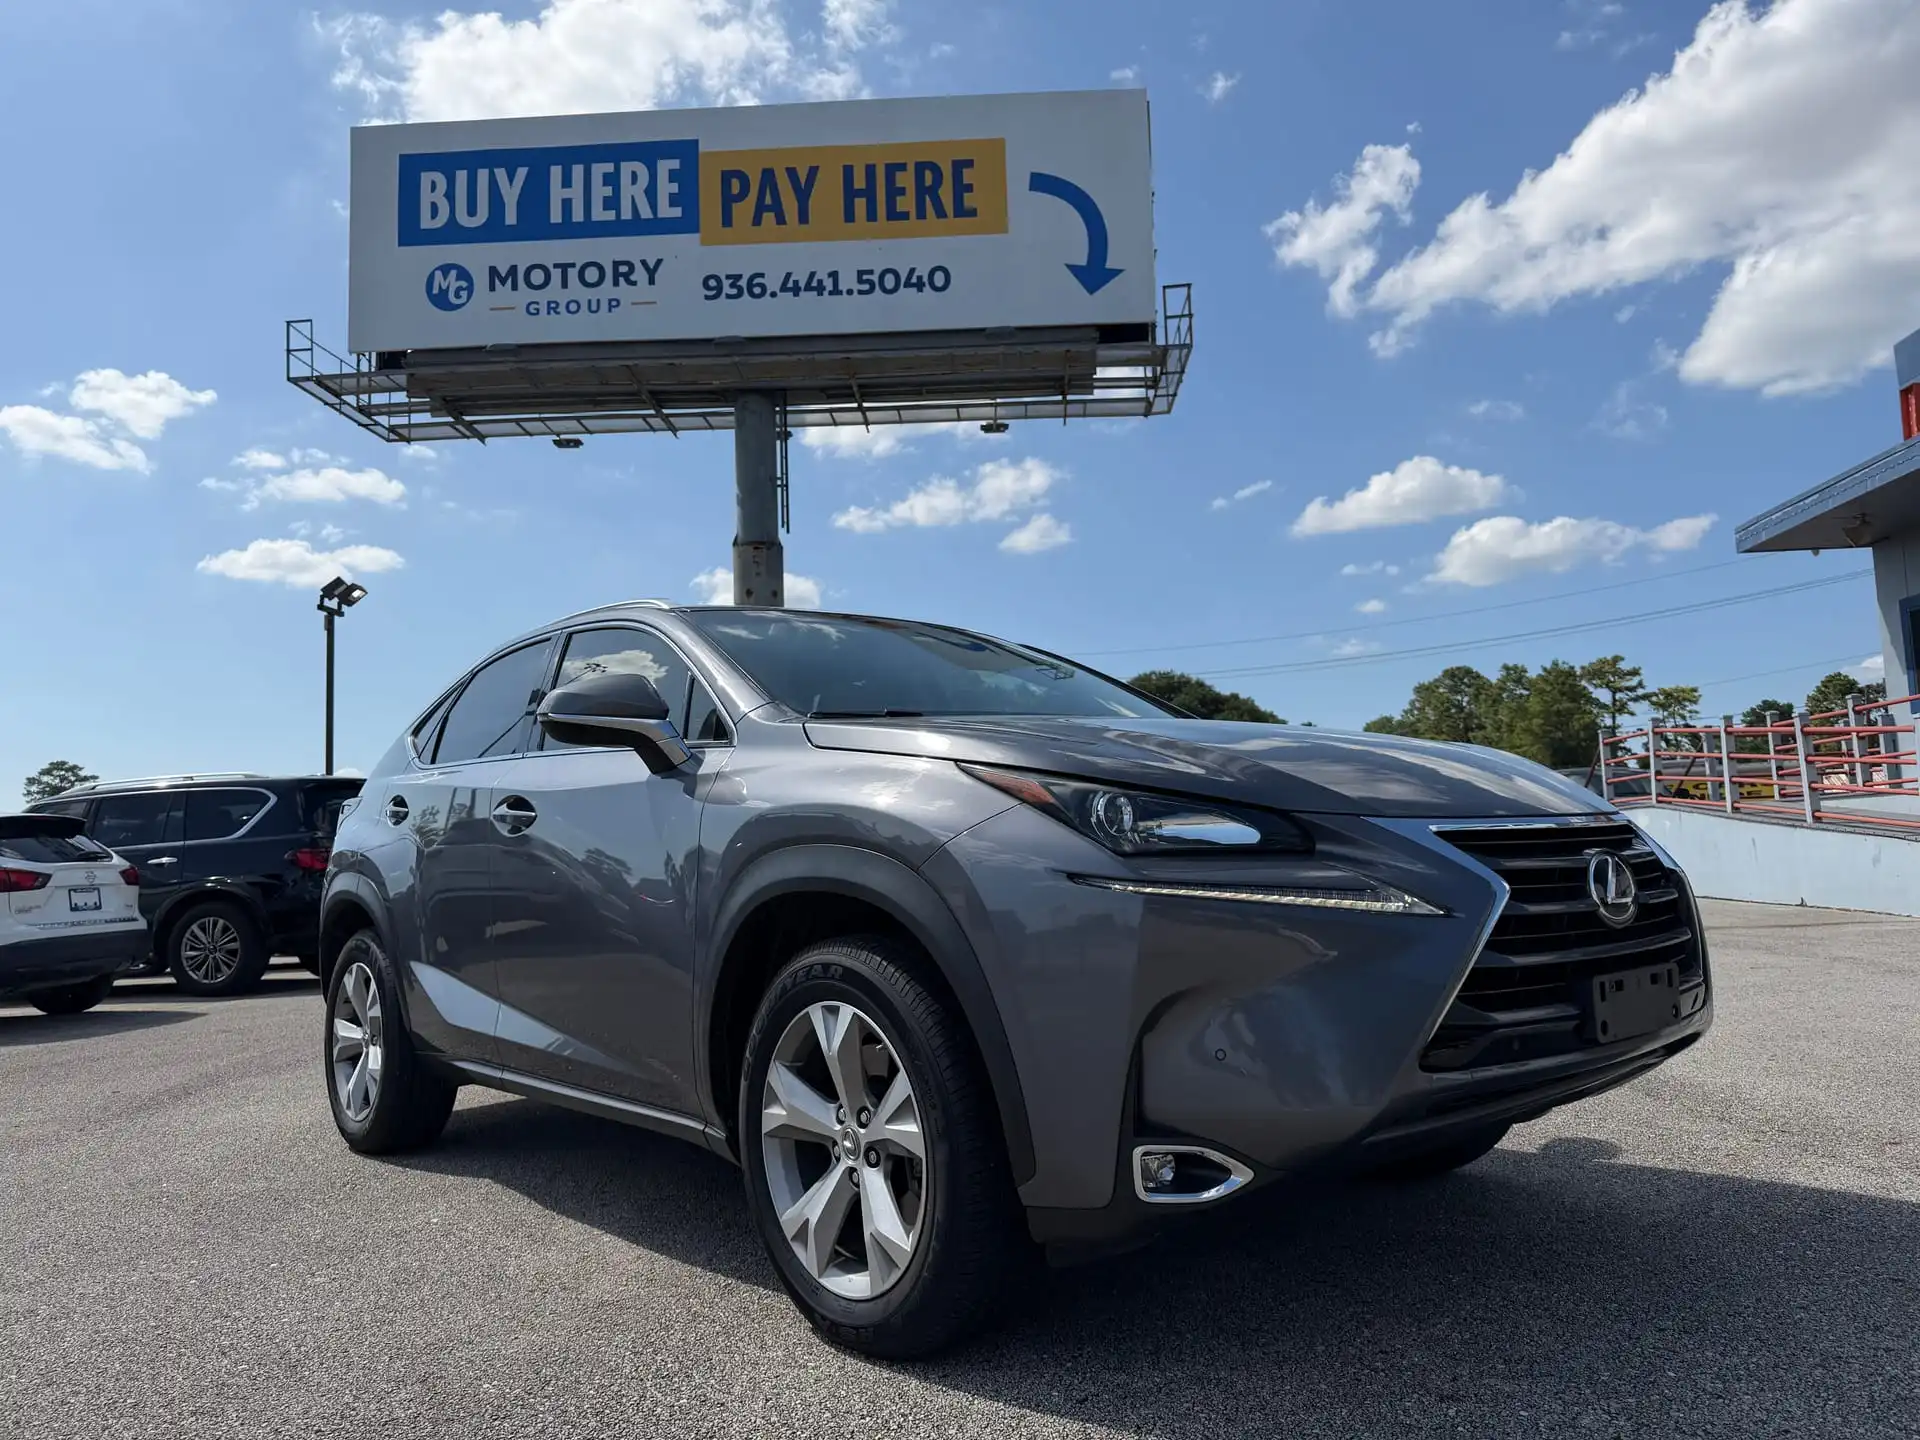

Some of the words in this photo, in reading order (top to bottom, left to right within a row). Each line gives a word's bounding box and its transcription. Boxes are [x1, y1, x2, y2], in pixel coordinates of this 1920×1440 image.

[420, 166, 529, 230] BUY
[549, 159, 683, 224] HERE
[720, 165, 820, 228] PAY
[842, 158, 978, 224] HERE
[432, 269, 469, 305] MG
[488, 258, 664, 292] MOTORY
[702, 265, 951, 301] 936.441.5040
[525, 297, 622, 317] GROUP
